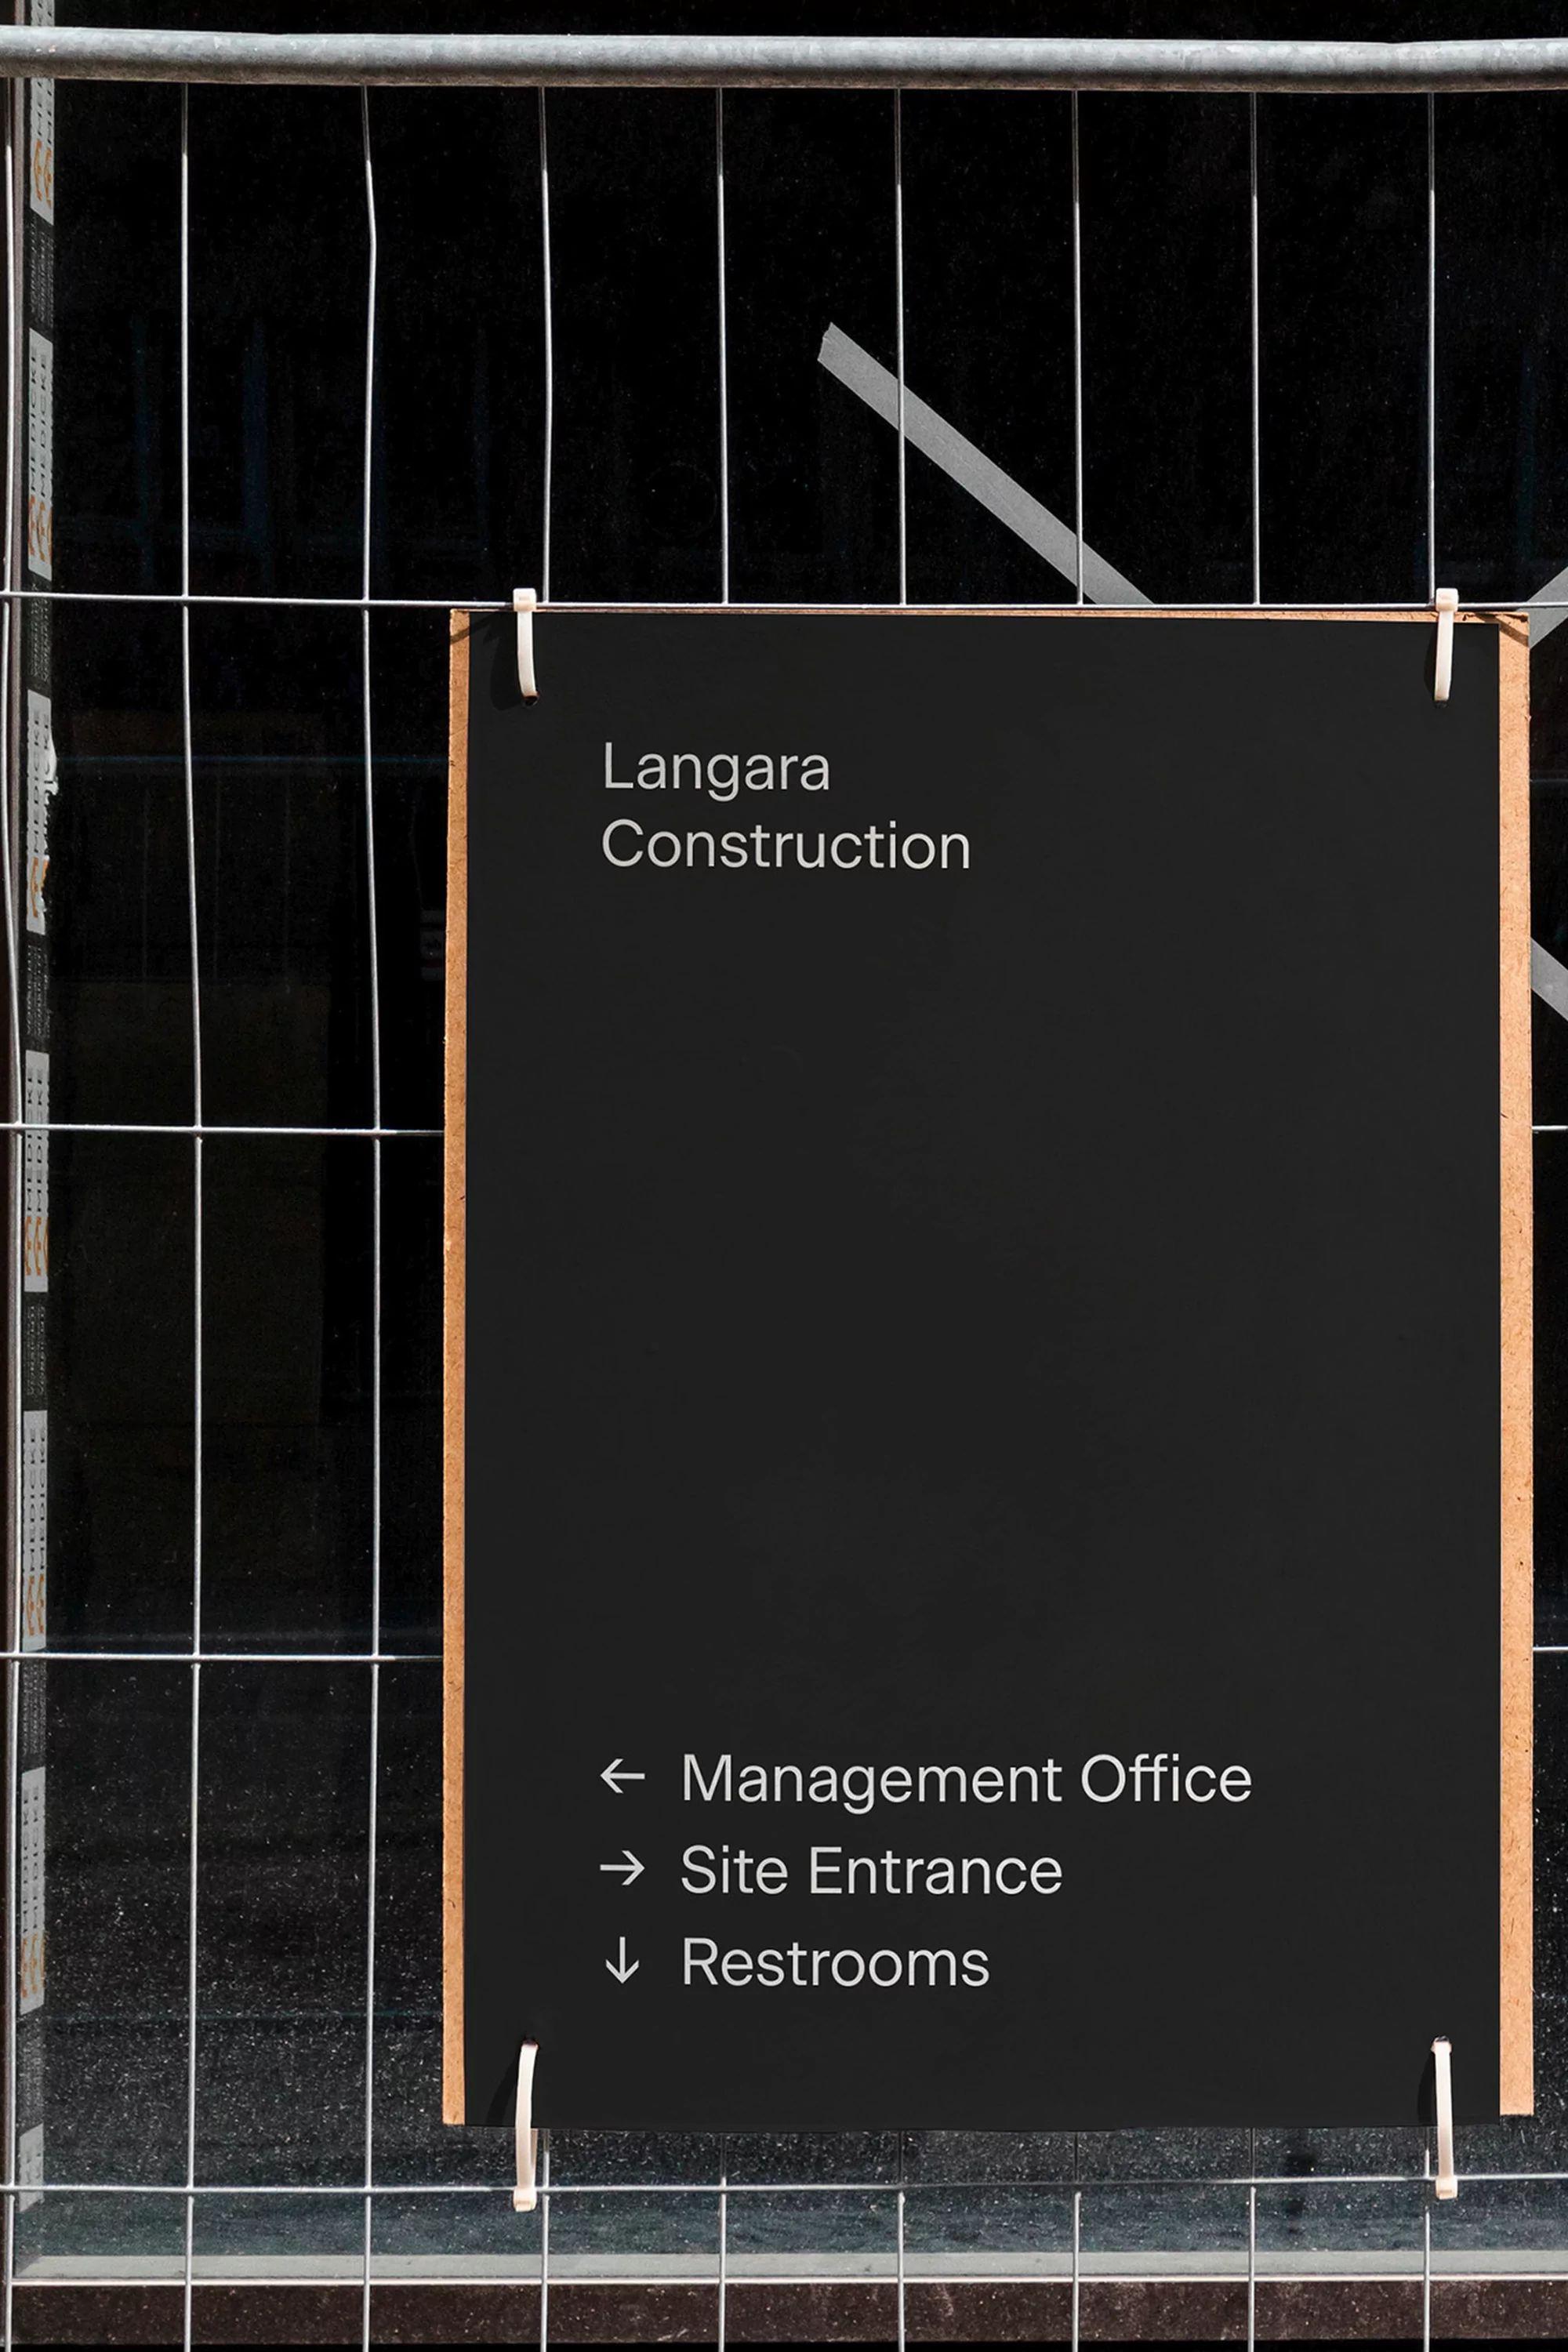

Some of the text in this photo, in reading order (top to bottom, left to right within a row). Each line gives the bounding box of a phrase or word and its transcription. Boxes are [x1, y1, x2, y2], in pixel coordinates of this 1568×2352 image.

[605, 742, 829, 801] Langara
[603, 819, 969, 869] Construction
[684, 1754, 1251, 1814] Management Office
[682, 1845, 1062, 1894] Site Entrance
[684, 1938, 989, 1987] Restrooms
